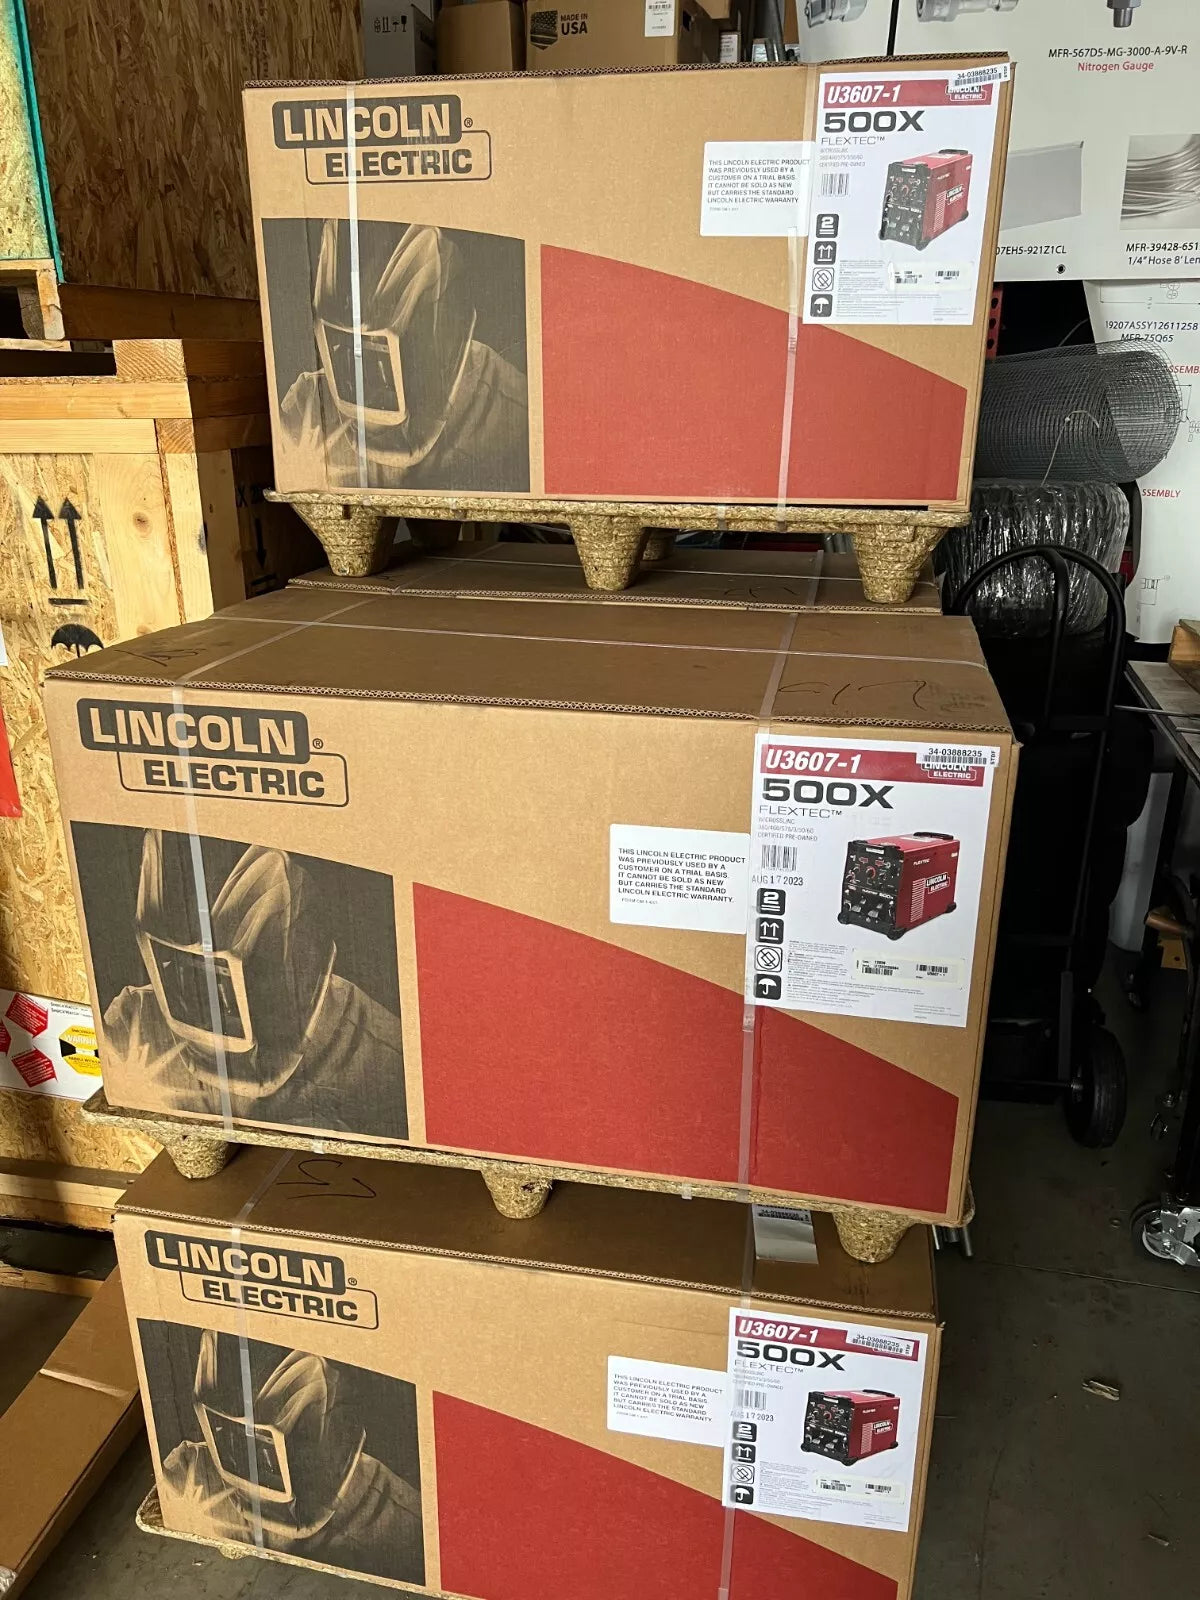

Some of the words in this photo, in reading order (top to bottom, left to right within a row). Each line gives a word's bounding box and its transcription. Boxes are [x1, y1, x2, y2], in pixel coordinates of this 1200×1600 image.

[561, 21, 588, 35] USA
[1048, 45, 1188, 58] MFR-567D5-MG-3000-A-9V-R
[1078, 62, 1120, 73] Nitrogen
[1123, 61, 1154, 72] Gauge
[827, 84, 901, 104] U3607-1
[283, 103, 450, 142] LINCOLN
[824, 110, 925, 133] 500X
[325, 148, 473, 178] ELECTRIC
[1126, 242, 1200, 252] MFR-39428-651
[1148, 256, 1172, 265] Hose
[1174, 255, 1183, 264] 8'
[1105, 320, 1198, 331] 19207ASSY12611258
[1168, 364, 1200, 374] SSEMB
[1142, 489, 1181, 498] SSEMBLY
[89, 707, 296, 756] LINCOLN
[928, 748, 982, 757] 34-03888235
[766, 749, 862, 774] U3607-1
[143, 759, 325, 798] ELECTRIC
[762, 778, 895, 809] 500X
[636, 850, 668, 858] LINCOLN
[670, 852, 707, 860] ELECTRIC
[709, 855, 746, 864] PRODUCT
[637, 858, 683, 867] PREVIOUSLY
[618, 864, 659, 873] CUSTOMER
[627, 873, 657, 881] CANNOT
[752, 875, 768, 884] AUG
[784, 876, 803, 886] 2023
[635, 881, 668, 889] CARRIES
[686, 885, 726, 894] STANDARD
[618, 888, 650, 896] LINCOLN
[652, 890, 689, 899] ELECTRIC
[690, 893, 734, 902] WARRANTY.
[763, 891, 779, 905] 2
[156, 1237, 334, 1289] LINCOLN
[202, 1279, 358, 1322] ELECTRIC
[738, 1319, 819, 1343] U3607-1
[736, 1340, 847, 1371] 500X
[614, 1386, 650, 1395] CUSTOMER
[630, 1376, 657, 1384] LINCOLN
[659, 1380, 690, 1389] ELECTRIC
[691, 1384, 722, 1394] PRODUCT
[630, 1382, 669, 1392] PREVIOUSLY
[614, 1404, 641, 1412] LINCOLN
[643, 1408, 674, 1417] ELECTRIC
[628, 1400, 656, 1408] CARRIES
[671, 1407, 707, 1416] STANDARD
[757, 1413, 774, 1422] 2023
